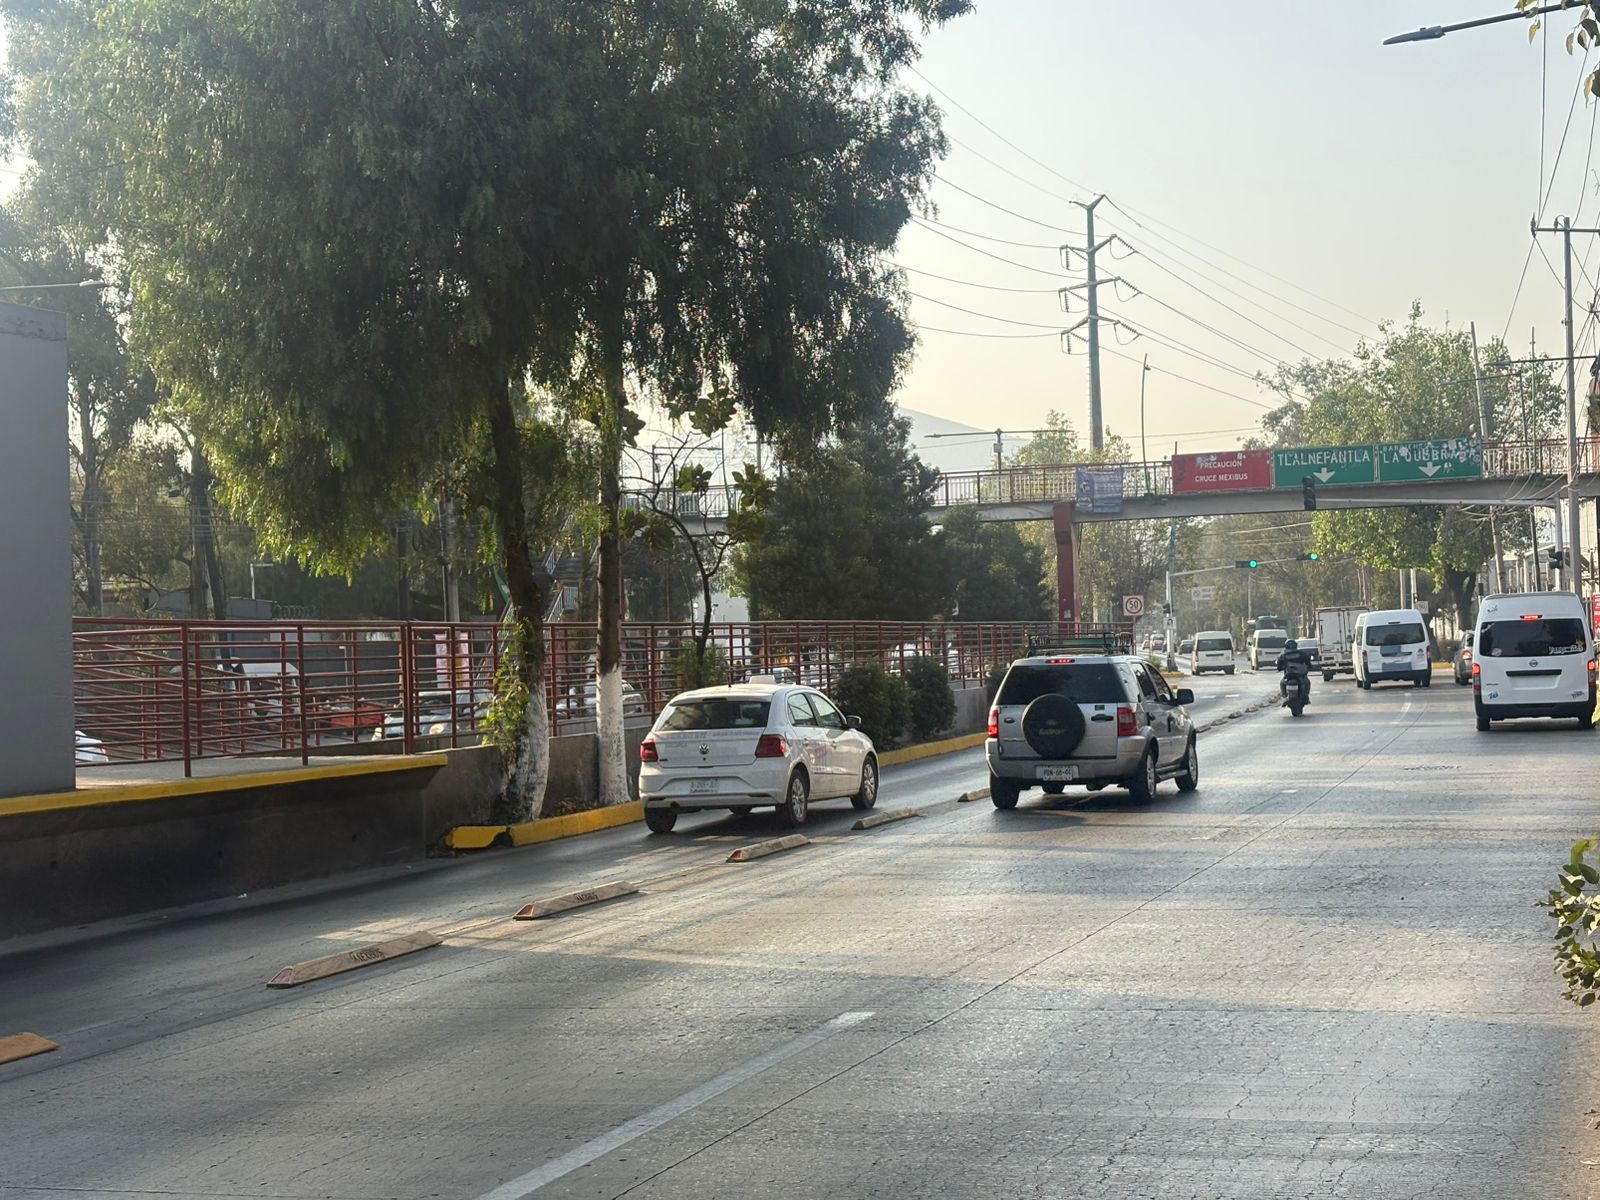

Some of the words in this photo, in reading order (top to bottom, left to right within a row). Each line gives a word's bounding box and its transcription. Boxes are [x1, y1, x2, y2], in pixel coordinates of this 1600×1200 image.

[1383, 451, 1399, 463] LA
[1200, 459, 1242, 469] PRECAUCIÓN
[1195, 474, 1217, 482] CRUCE
[1218, 472, 1248, 481] MEXIBUS
[1129, 601, 1139, 610] 50
